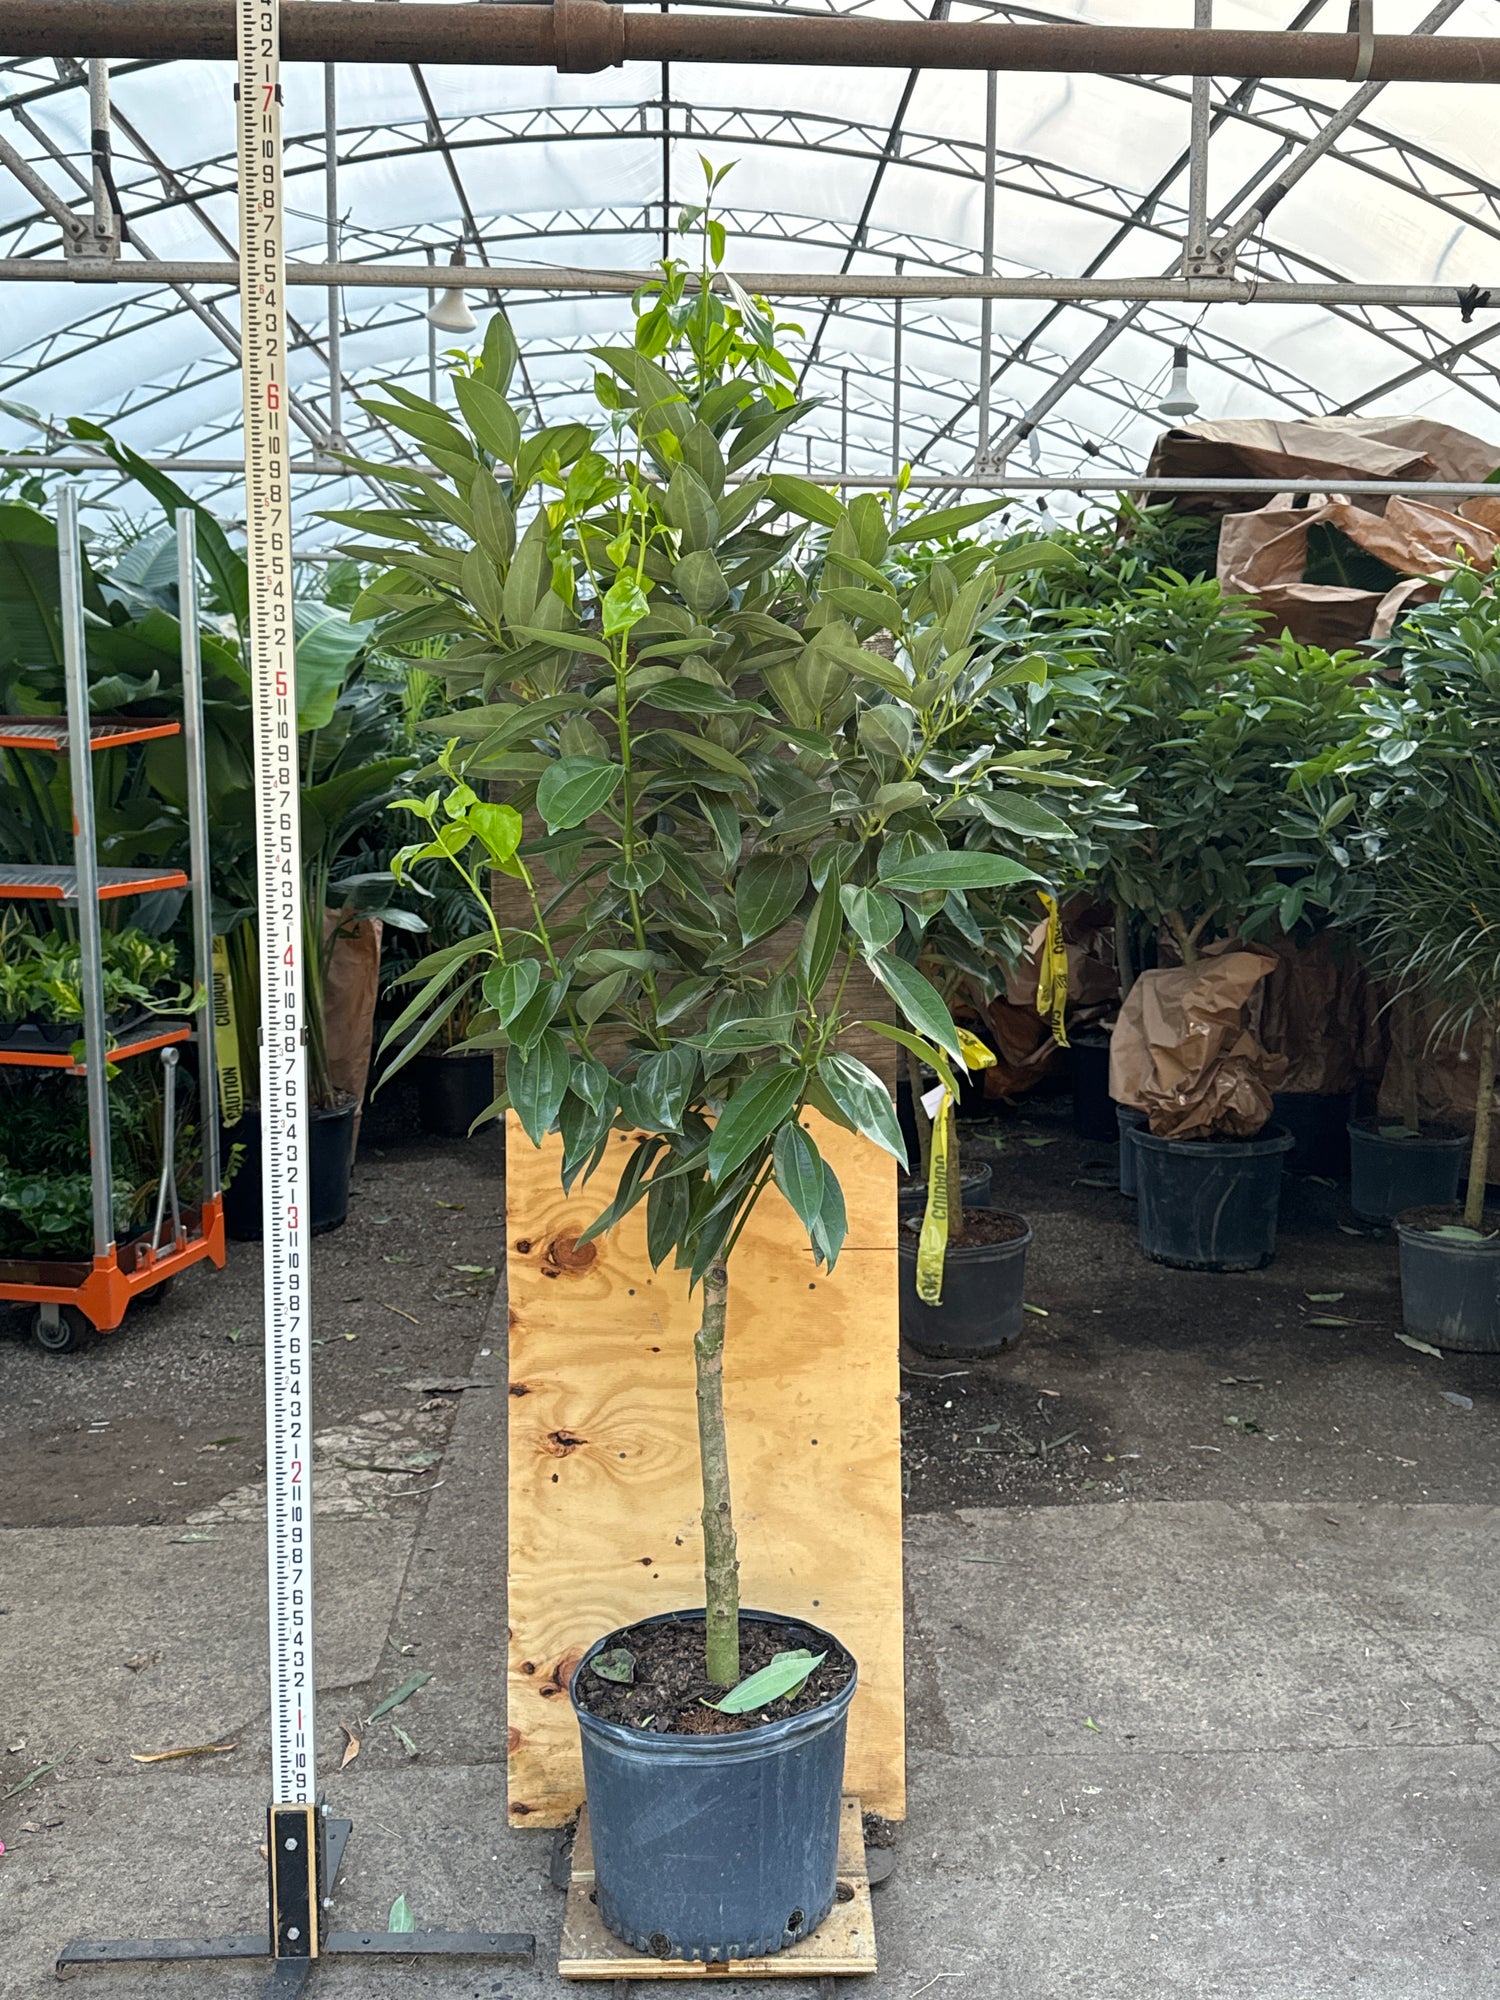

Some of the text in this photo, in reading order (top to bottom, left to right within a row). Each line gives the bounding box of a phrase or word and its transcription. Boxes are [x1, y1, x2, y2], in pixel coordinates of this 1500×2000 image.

[260, 12, 273, 33] 3
[260, 38, 273, 58] 2
[261, 85, 274, 113] 7
[262, 114, 273, 134] 11
[261, 139, 274, 159] 10
[262, 164, 275, 184] 9
[262, 189, 275, 209] 8
[263, 214, 275, 234] 7
[263, 239, 276, 259] 6
[264, 263, 276, 283] 5
[264, 288, 277, 308] 4
[265, 313, 278, 333] 3
[265, 338, 278, 357] 2
[267, 383, 280, 410] 6
[268, 411, 279, 431] 11
[268, 436, 281, 455] 10
[269, 460, 281, 479] 9
[269, 484, 282, 503] 8
[270, 508, 282, 527] 7
[271, 532, 283, 551] 6
[272, 556, 284, 575] 5
[273, 580, 285, 599] 4
[273, 603, 286, 623] 3
[274, 627, 286, 646] 2
[275, 671, 288, 697] 5
[277, 698, 287, 716] 11
[277, 721, 289, 739] 10
[277, 744, 290, 762] 9
[278, 767, 290, 785] 8
[279, 790, 291, 808] 7
[279, 813, 291, 831] 6
[280, 835, 292, 853] 5
[281, 858, 293, 876] 4
[281, 880, 293, 898] 3
[282, 903, 294, 921] 2
[283, 944, 295, 968] 4
[284, 970, 294, 987] 11
[284, 992, 296, 1009] 10
[284, 1014, 296, 1031] 9
[284, 1036, 296, 1053] 8
[285, 1058, 296, 1075] 7
[222, 1066, 242, 1121] CAUTION
[285, 1079, 297, 1097] 6
[285, 1101, 297, 1119] 5
[286, 1123, 297, 1140] 4
[286, 1145, 298, 1162] 3
[287, 1166, 298, 1183] 2
[287, 1206, 299, 1229] 3
[289, 1231, 298, 1248] 11
[288, 1252, 300, 1269] 10
[288, 1273, 300, 1291] 9
[289, 1295, 300, 1312] 8
[289, 1316, 300, 1333] 7
[289, 1337, 301, 1354] 6
[290, 1358, 301, 1375] 5
[290, 1379, 301, 1396] 4
[290, 1400, 302, 1418] 3
[290, 1422, 302, 1439] 2
[290, 1460, 302, 1484] 2
[292, 1485, 301, 1502] 11
[291, 1506, 303, 1522] 10
[291, 1527, 303, 1544] 9
[292, 1547, 303, 1564] 8
[292, 1568, 303, 1585] 7
[292, 1589, 304, 1606] 6
[292, 1609, 304, 1626] 5
[293, 1630, 304, 1647] 4
[293, 1651, 305, 1667] 3
[293, 1671, 305, 1688] 2
[296, 1732, 305, 1748] 11
[295, 1752, 306, 1769] 10
[295, 1772, 307, 1789] 9
[296, 1792, 307, 1803] 8
